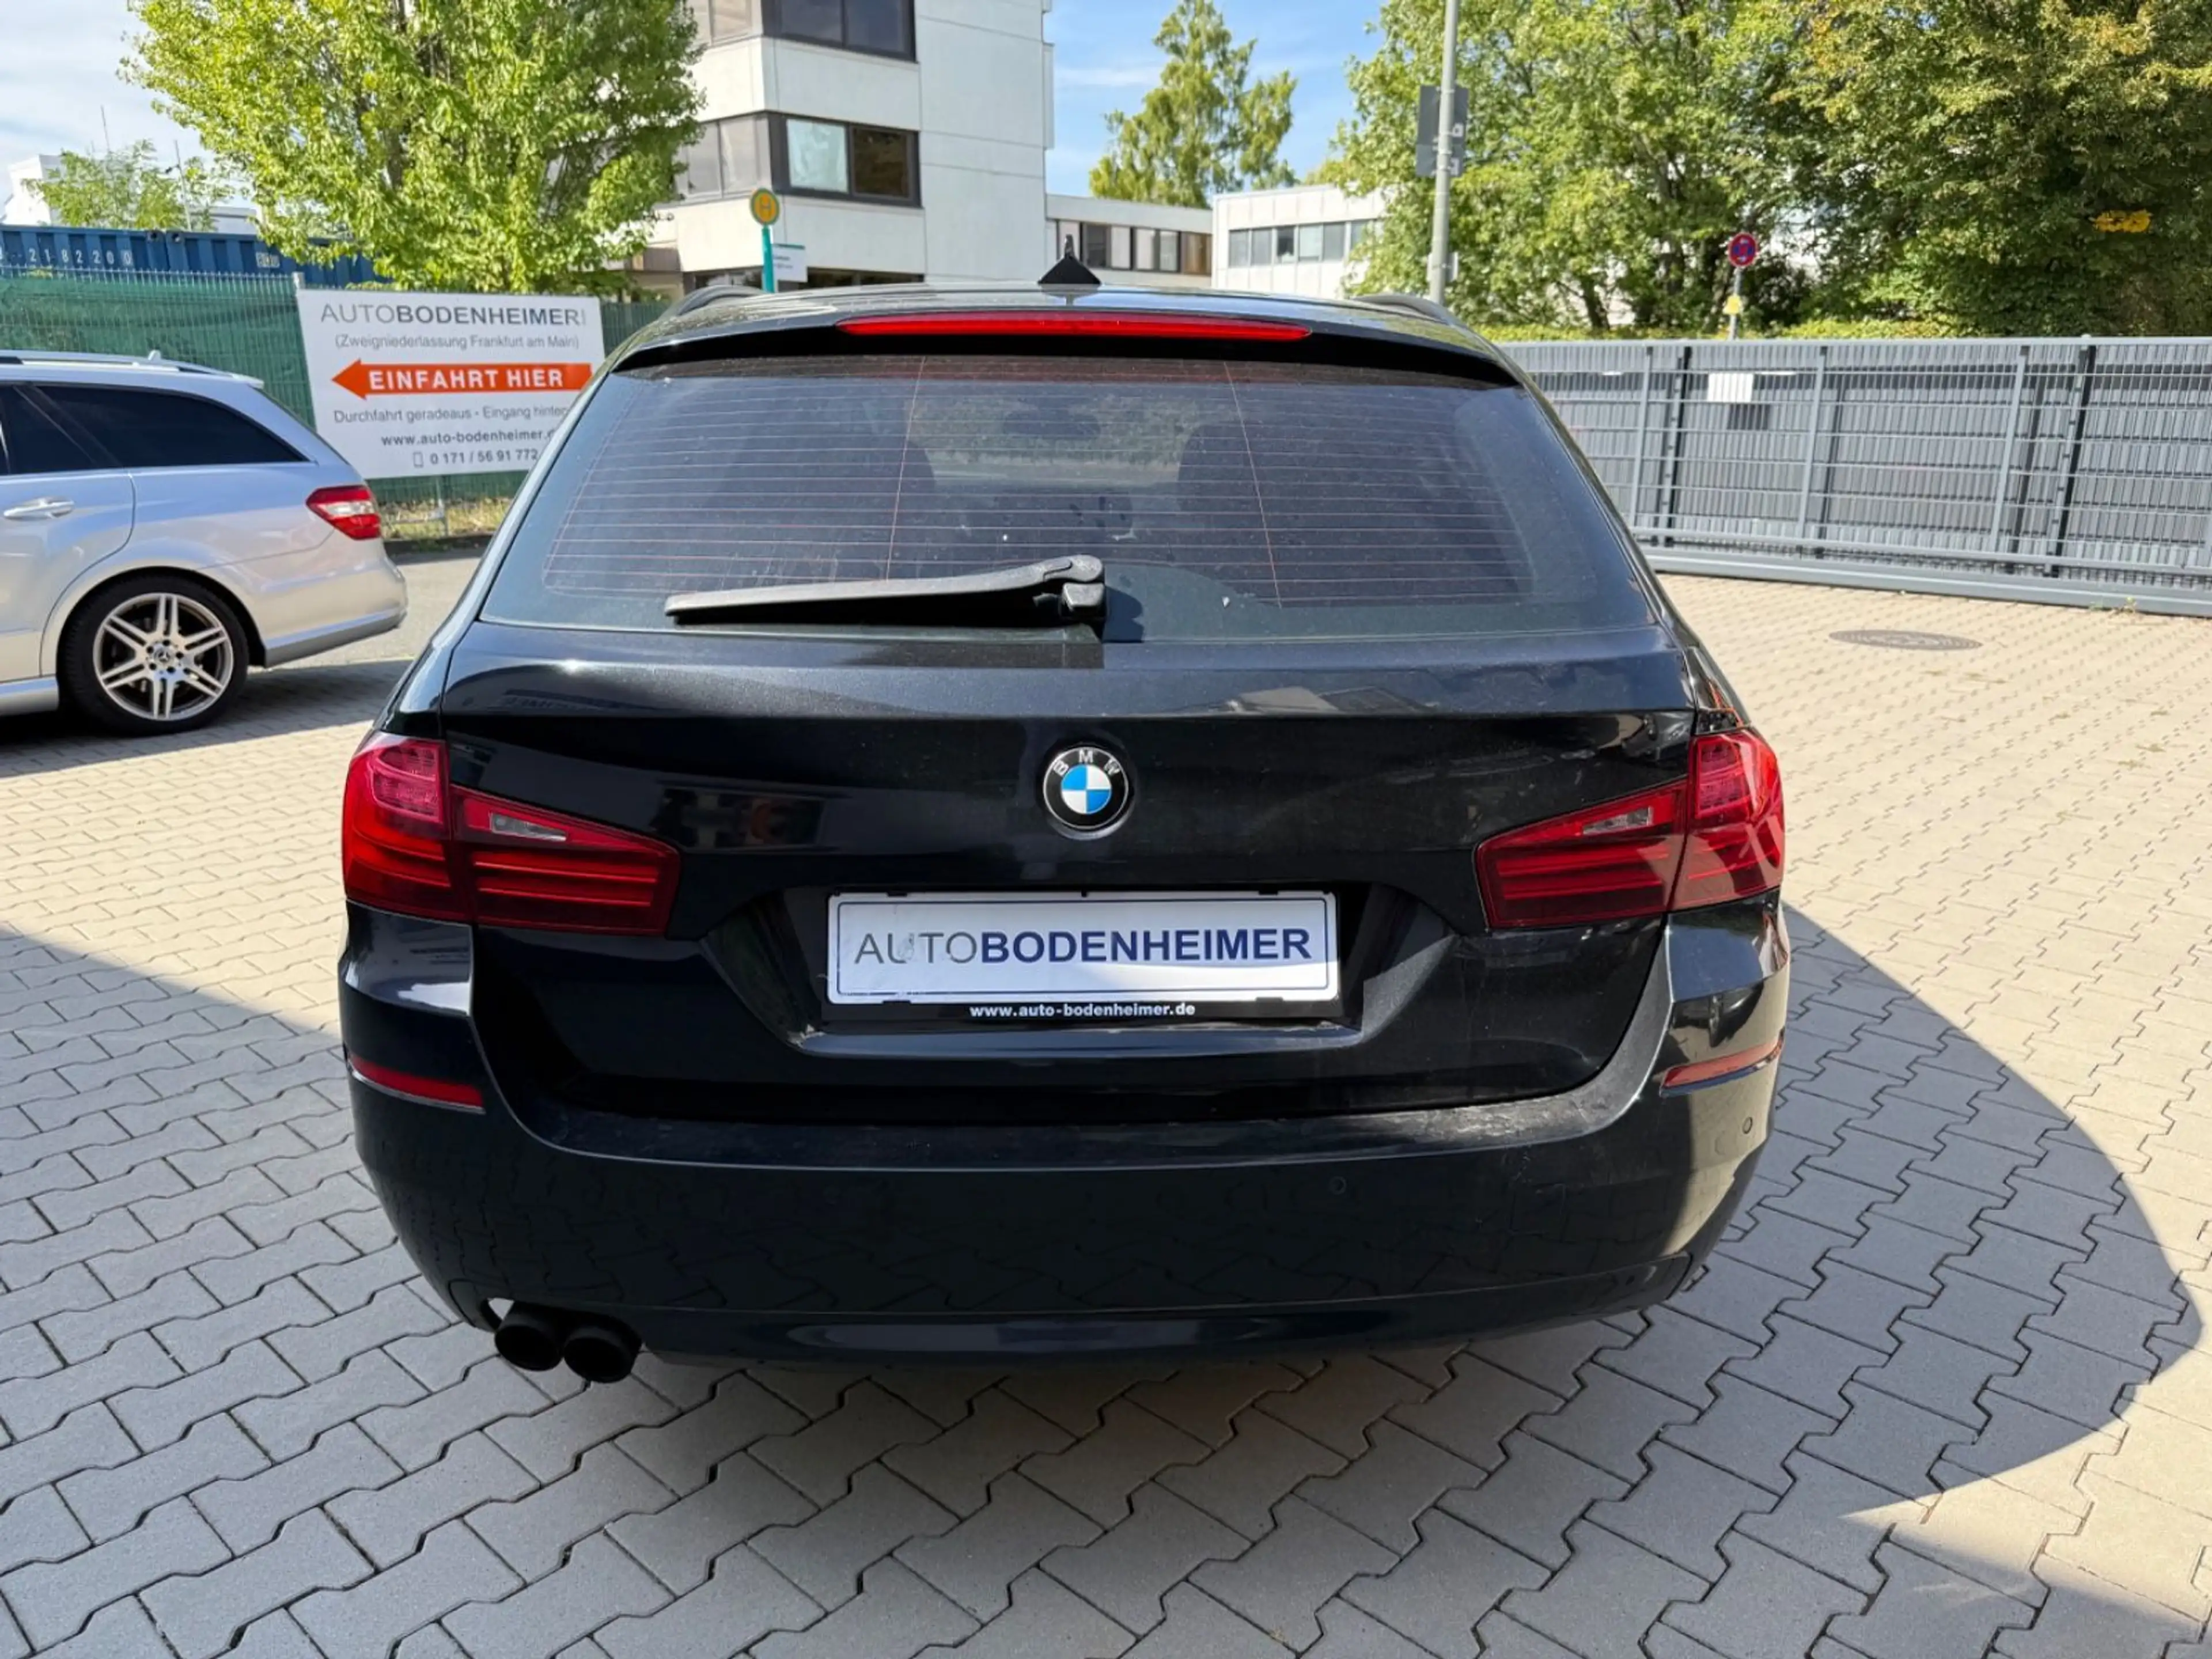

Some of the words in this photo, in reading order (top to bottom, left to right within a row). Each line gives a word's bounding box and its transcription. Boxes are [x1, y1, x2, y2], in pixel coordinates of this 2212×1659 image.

[335, 334, 467, 350] (Zweigniederlassung
[470, 335, 524, 347] Frankfurt
[527, 337, 545, 347] am
[548, 335, 579, 350] Main)
[369, 369, 498, 390] EINFAHRT
[507, 369, 563, 388] HIER
[334, 409, 403, 423] Durchfahrt
[406, 408, 472, 423] geradeaus
[482, 406, 531, 421] Eingang
[496, 449, 511, 461] 91
[1053, 749, 1121, 777] BMW
[854, 929, 1312, 964] AUTOBODENHEIMER
[969, 1003, 1195, 1017] www.auto-bodenheimer.de
